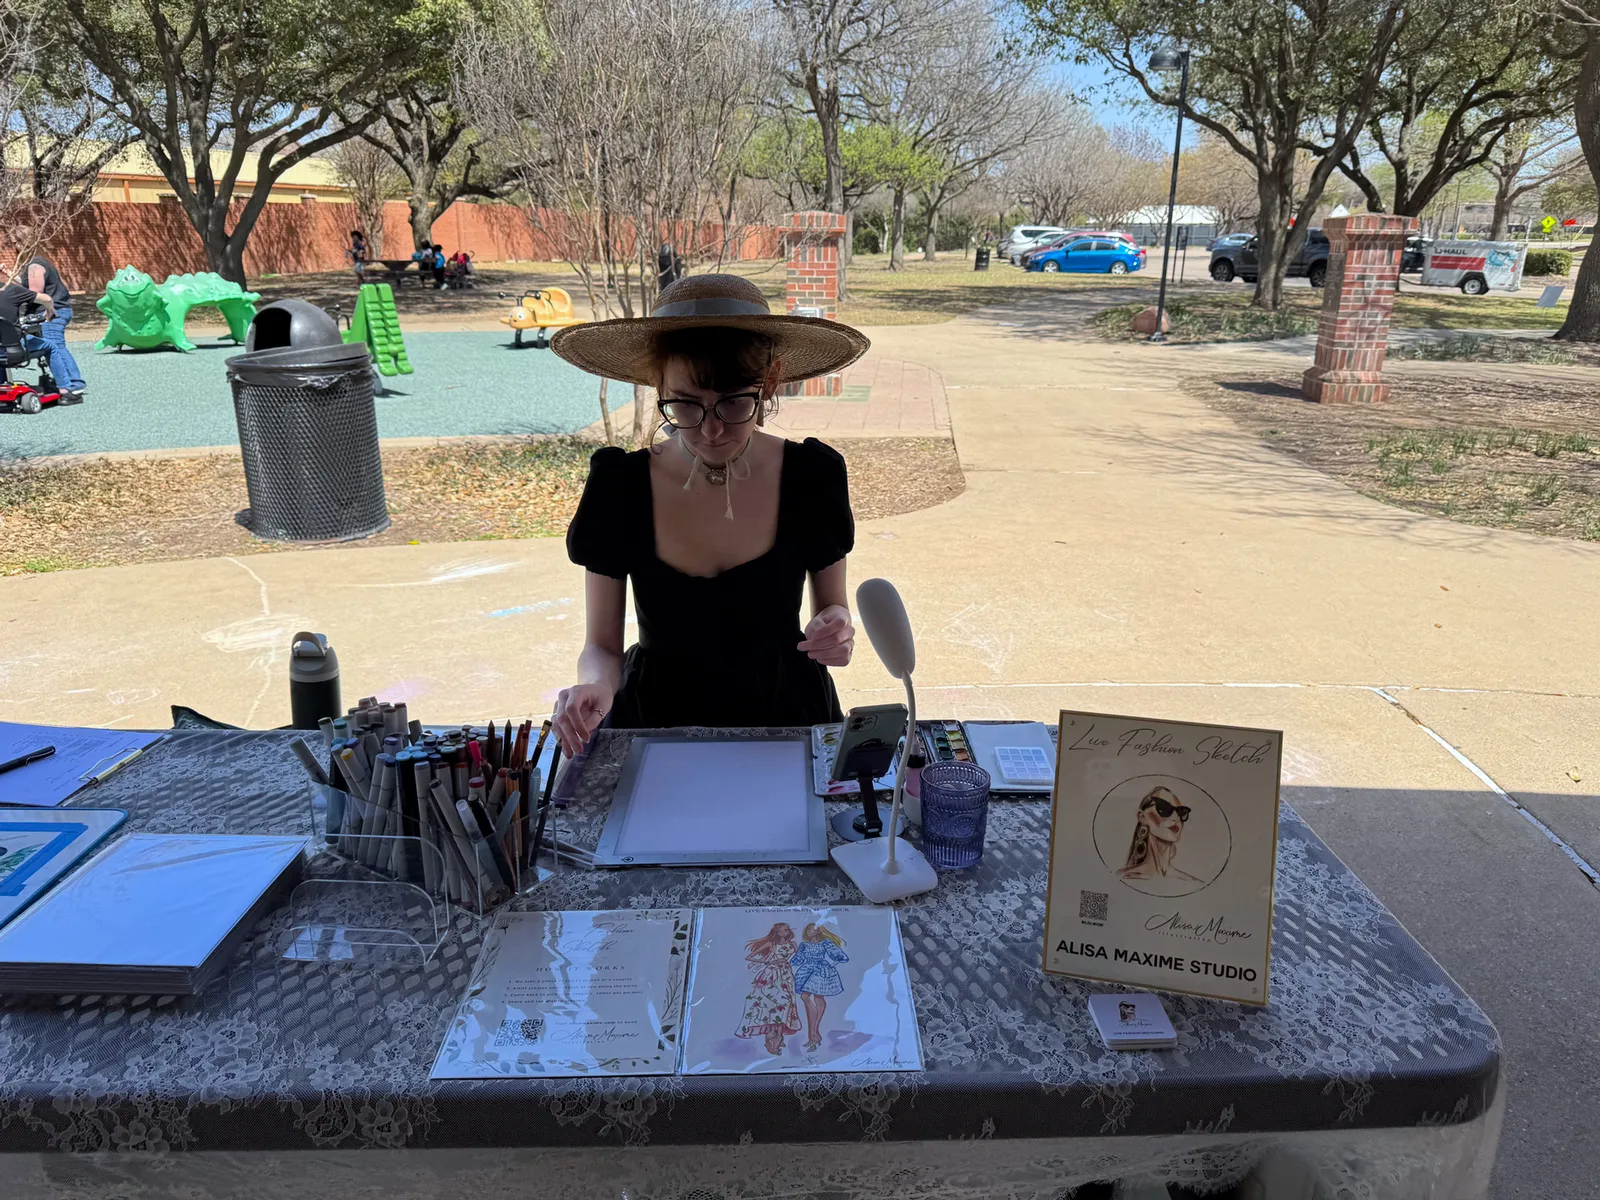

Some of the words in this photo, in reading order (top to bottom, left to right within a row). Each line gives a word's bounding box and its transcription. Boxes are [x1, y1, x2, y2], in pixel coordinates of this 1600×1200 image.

[1068, 724, 1111, 751] Live
[1116, 728, 1185, 757] Fashion
[1192, 735, 1272, 766] Sketch
[1144, 911, 1197, 931] Alisa
[1194, 916, 1252, 945] Maxime
[1055, 939, 1109, 960] ALISA
[1113, 948, 1185, 972] MAXIME
[1189, 959, 1257, 982] STUDIO
